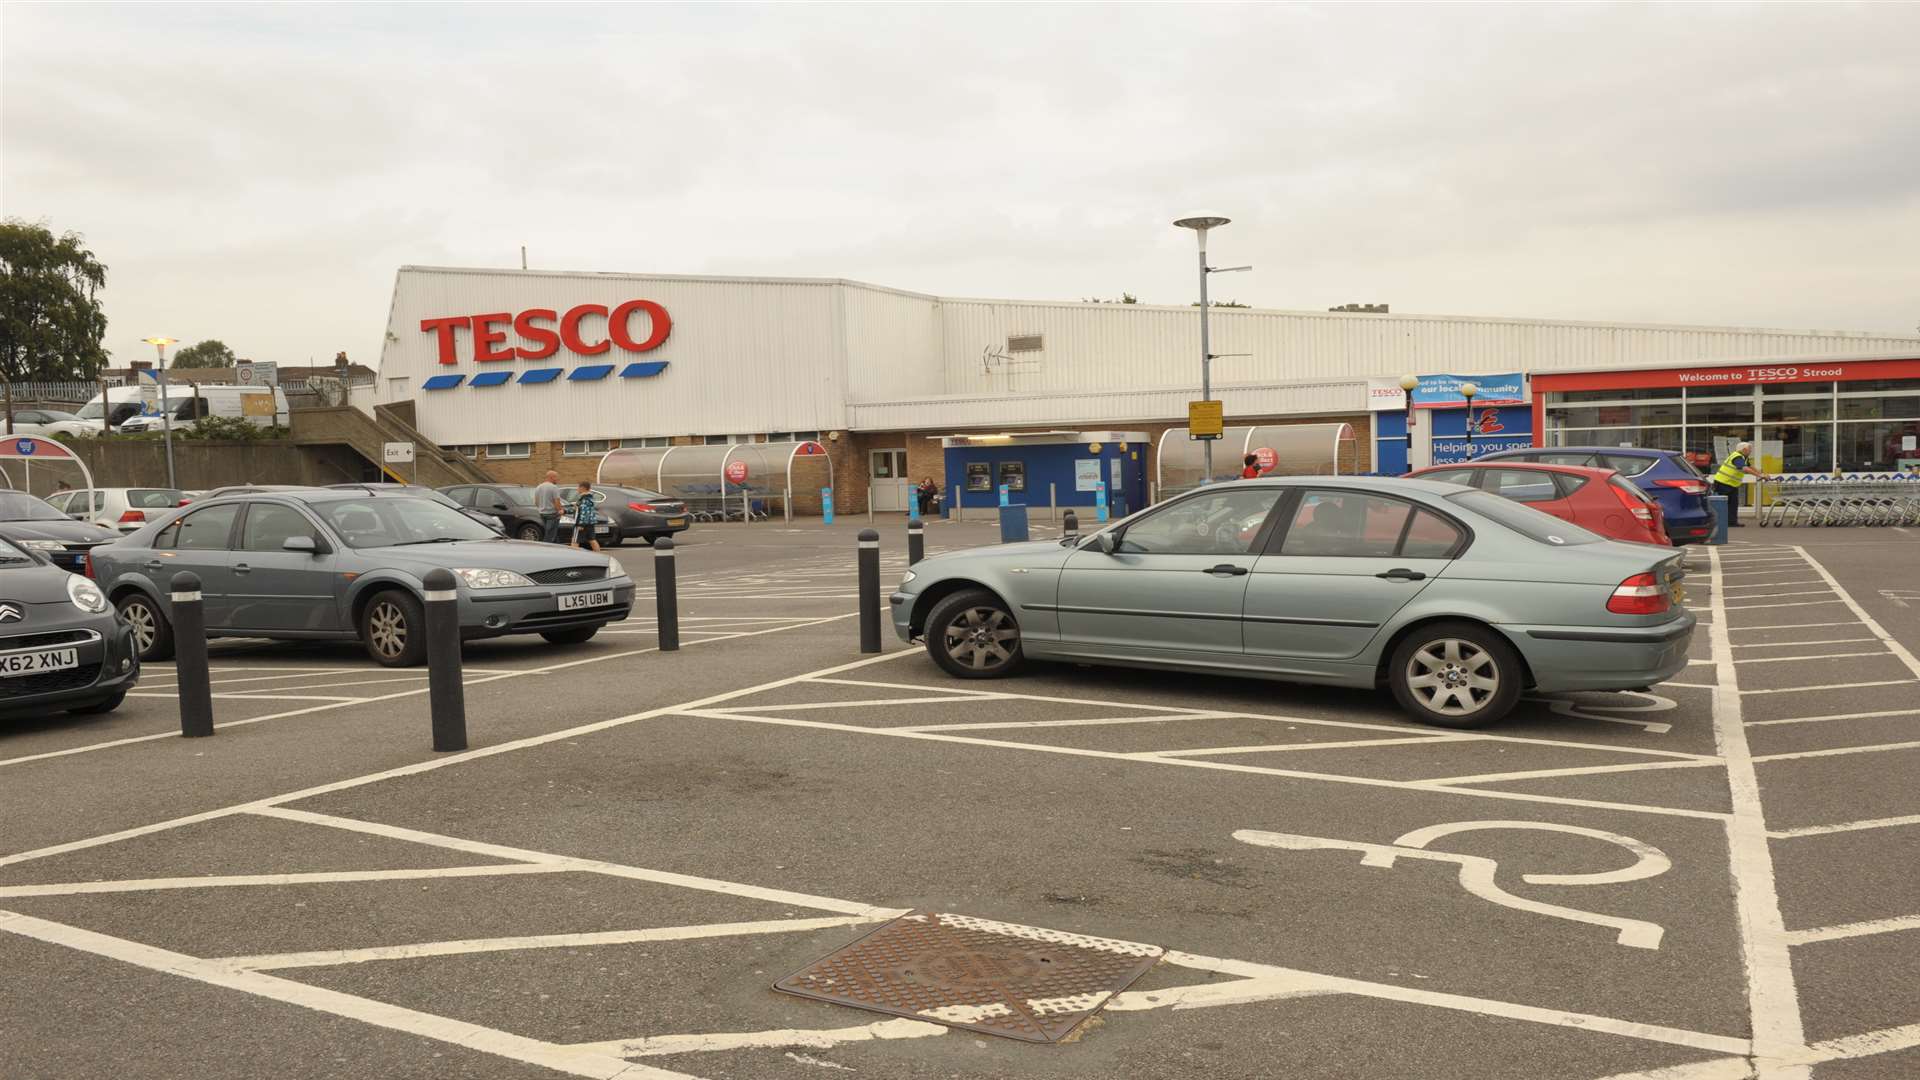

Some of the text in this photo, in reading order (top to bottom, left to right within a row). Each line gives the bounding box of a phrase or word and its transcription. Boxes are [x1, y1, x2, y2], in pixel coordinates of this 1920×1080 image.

[420, 299, 672, 365] TESCO
[1679, 367, 1842, 382] Welcome to TESCO Strood
[1370, 389, 1402, 397] TESCO
[386, 448, 400, 457] Exit
[1480, 443, 1503, 454] you
[564, 592, 609, 608] LX51 UBW
[0, 650, 74, 672] X62 XNJ
